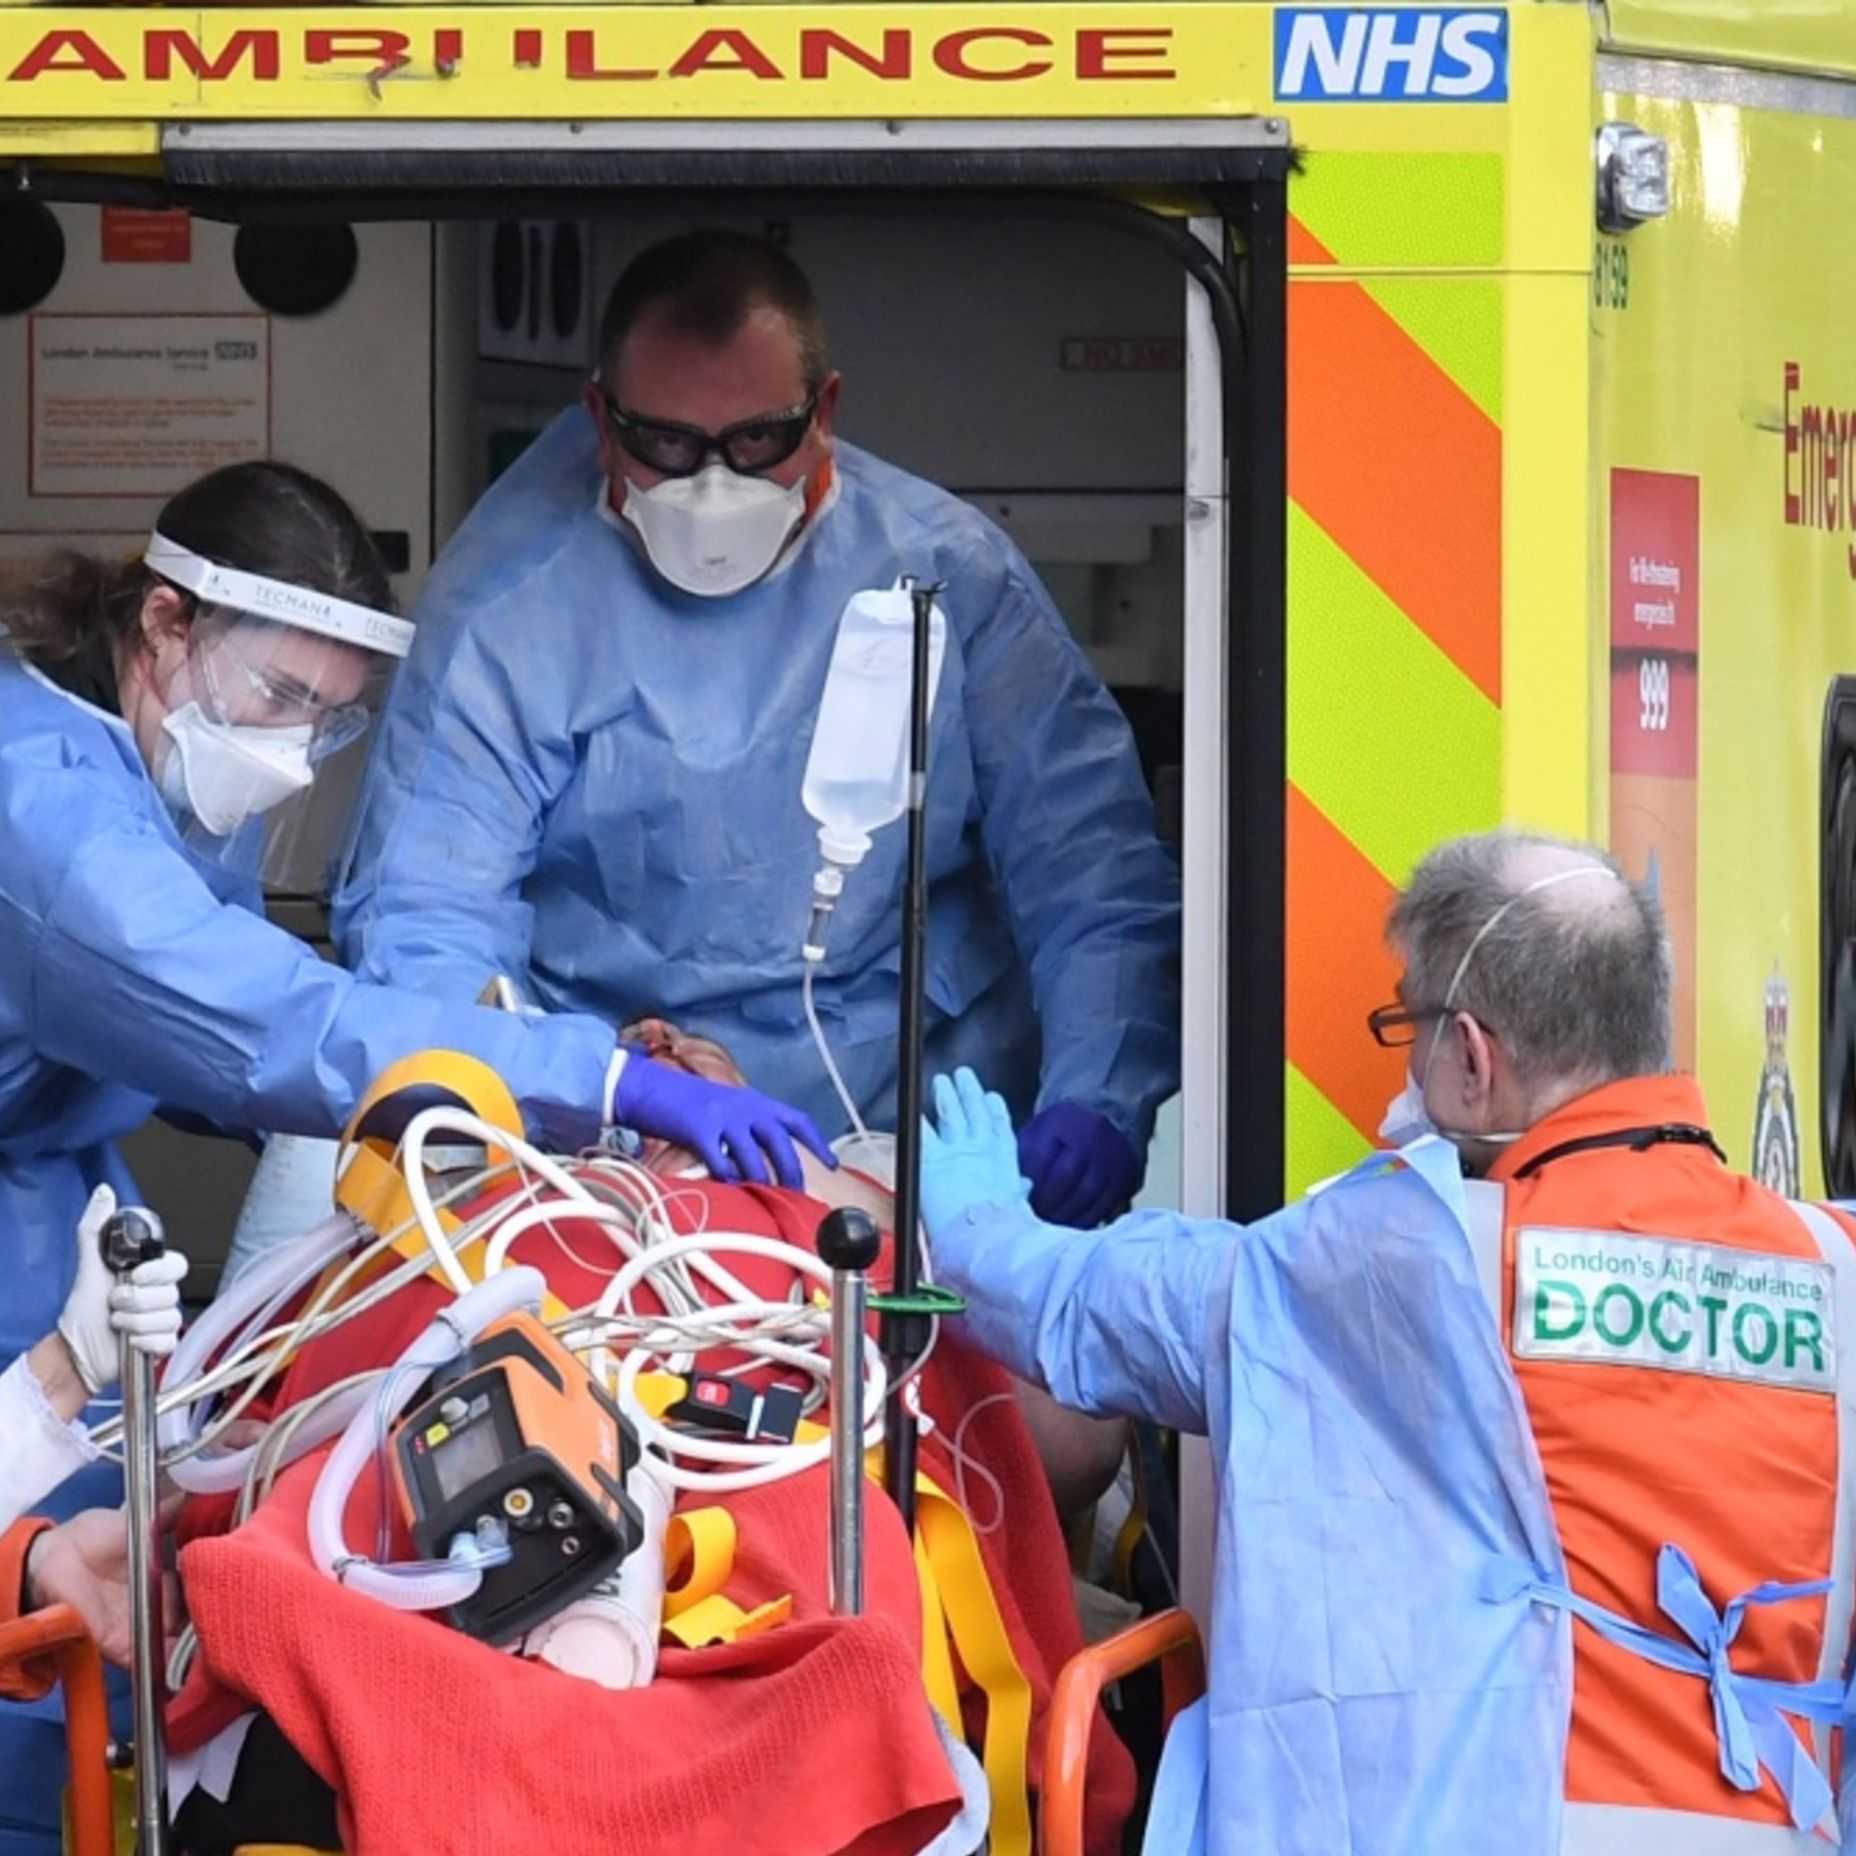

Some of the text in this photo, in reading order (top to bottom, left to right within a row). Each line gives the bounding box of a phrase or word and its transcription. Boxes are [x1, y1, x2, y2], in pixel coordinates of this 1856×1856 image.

[1278, 13, 1499, 97] NHS
[1640, 659, 1670, 731] 999
[1534, 1246, 1823, 1301] London's Air Ambulance
[1533, 1279, 1825, 1372] DOCTOR
